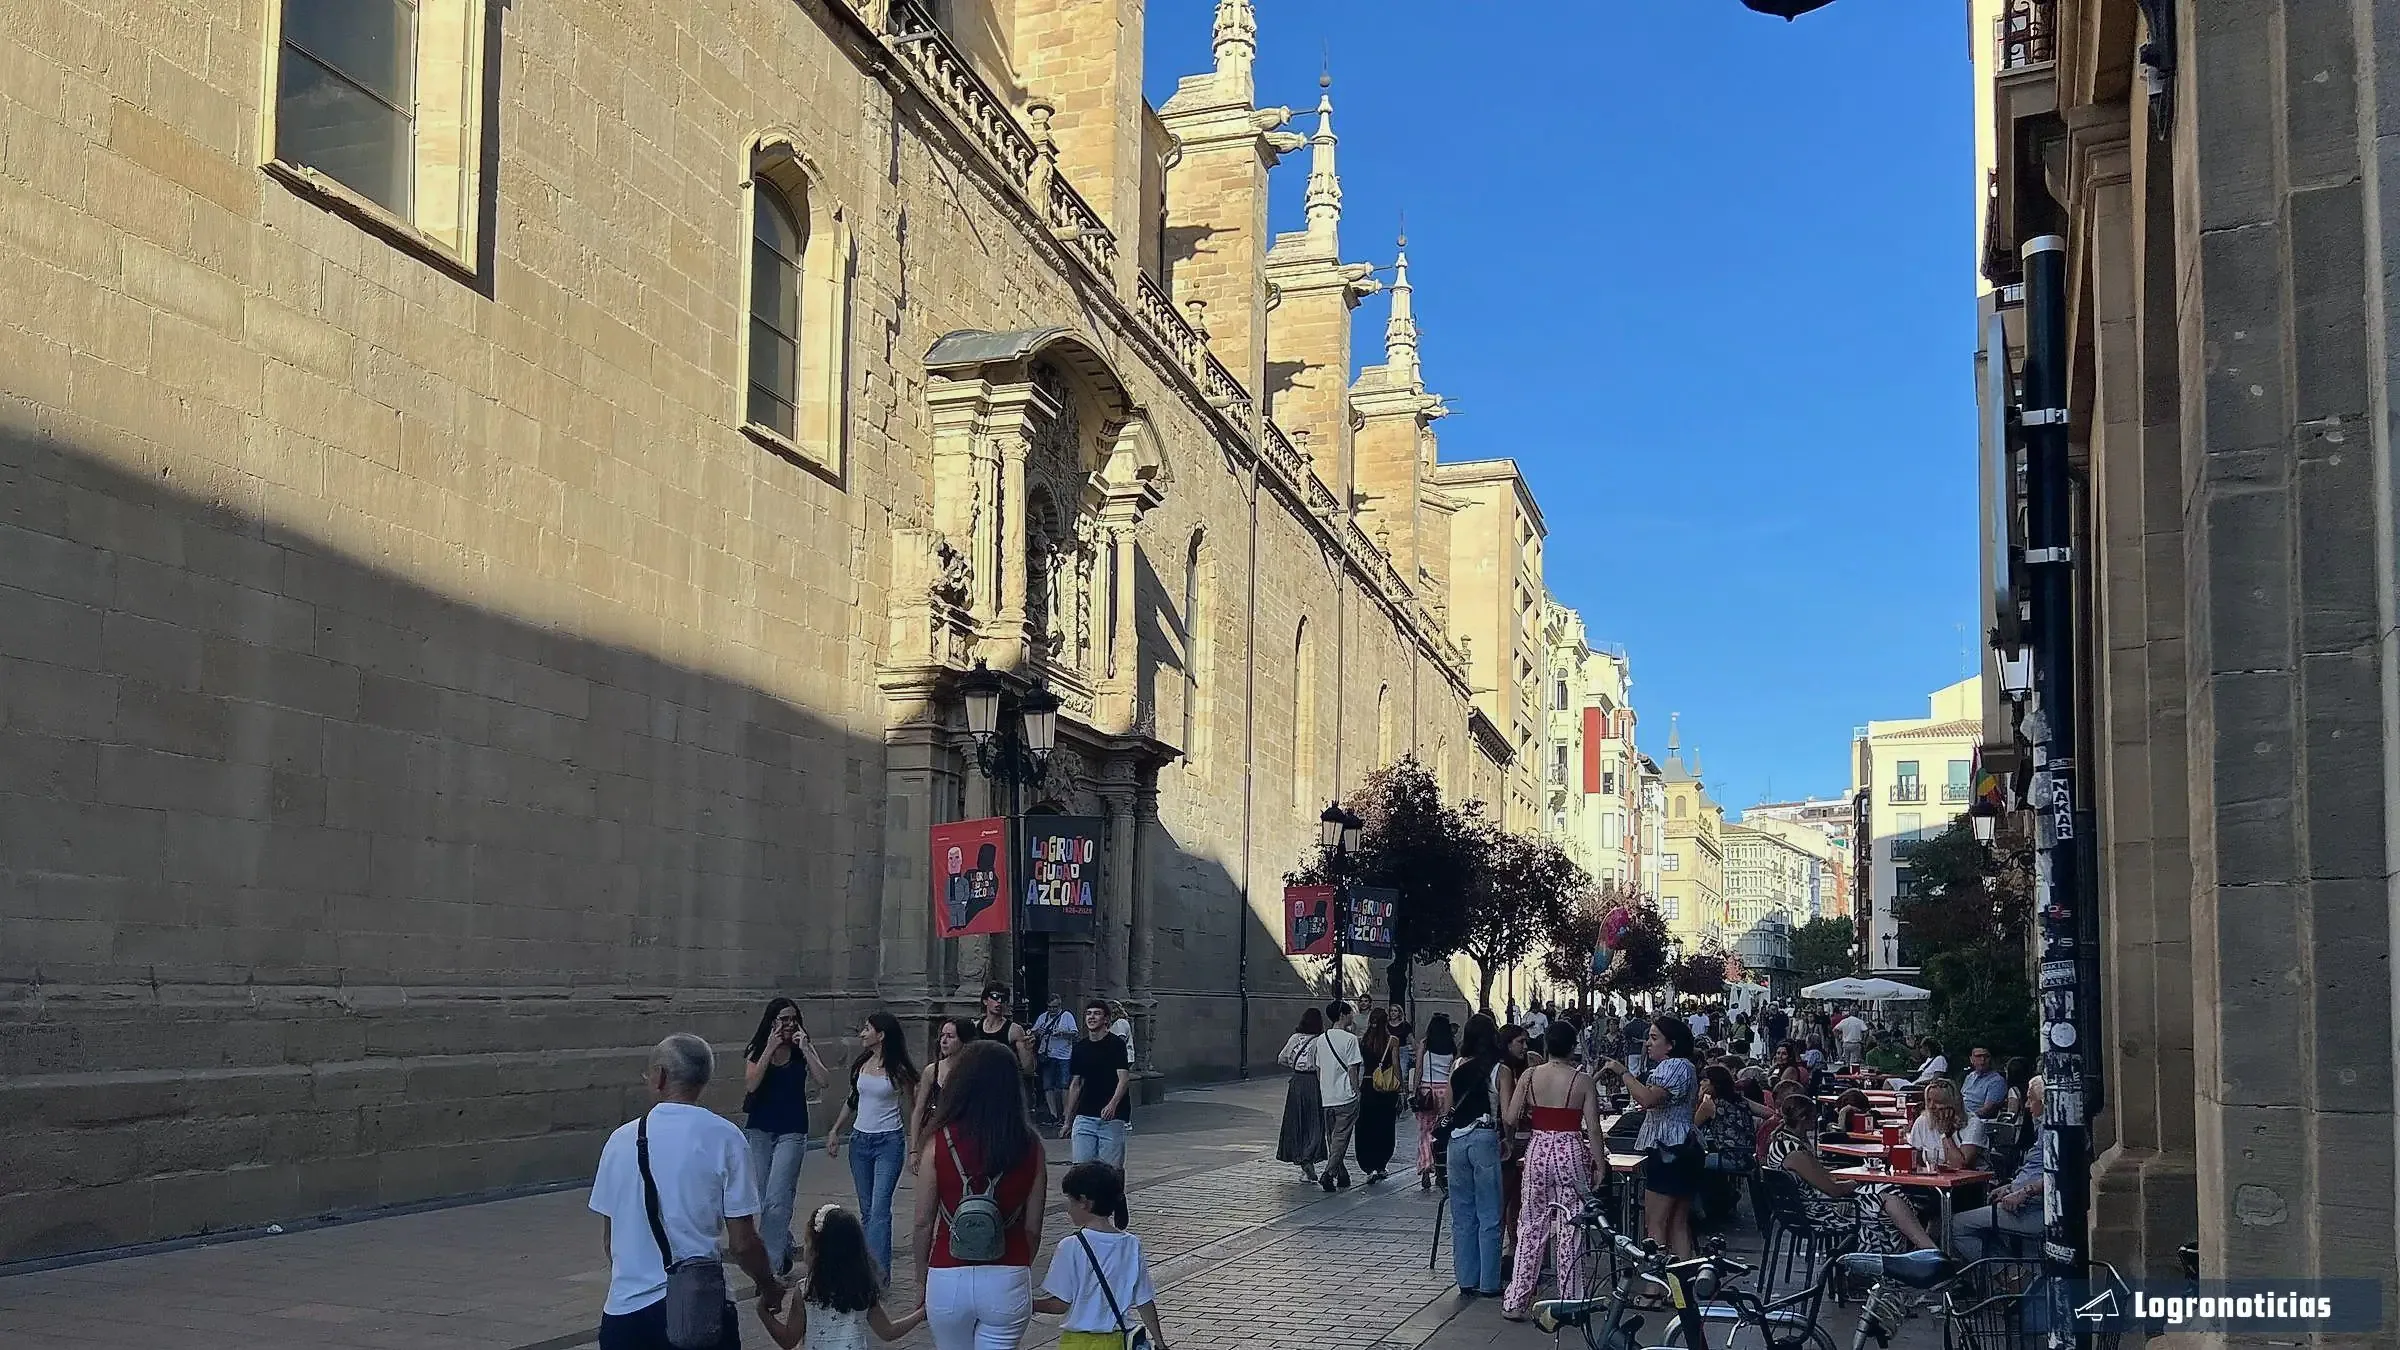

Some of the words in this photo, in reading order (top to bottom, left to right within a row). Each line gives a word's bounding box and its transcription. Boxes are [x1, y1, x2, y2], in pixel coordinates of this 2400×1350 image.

[2052, 780, 2073, 838] NAKAR
[1025, 879, 1093, 906] AZCONA
[1346, 924, 1391, 942] AZCONA
